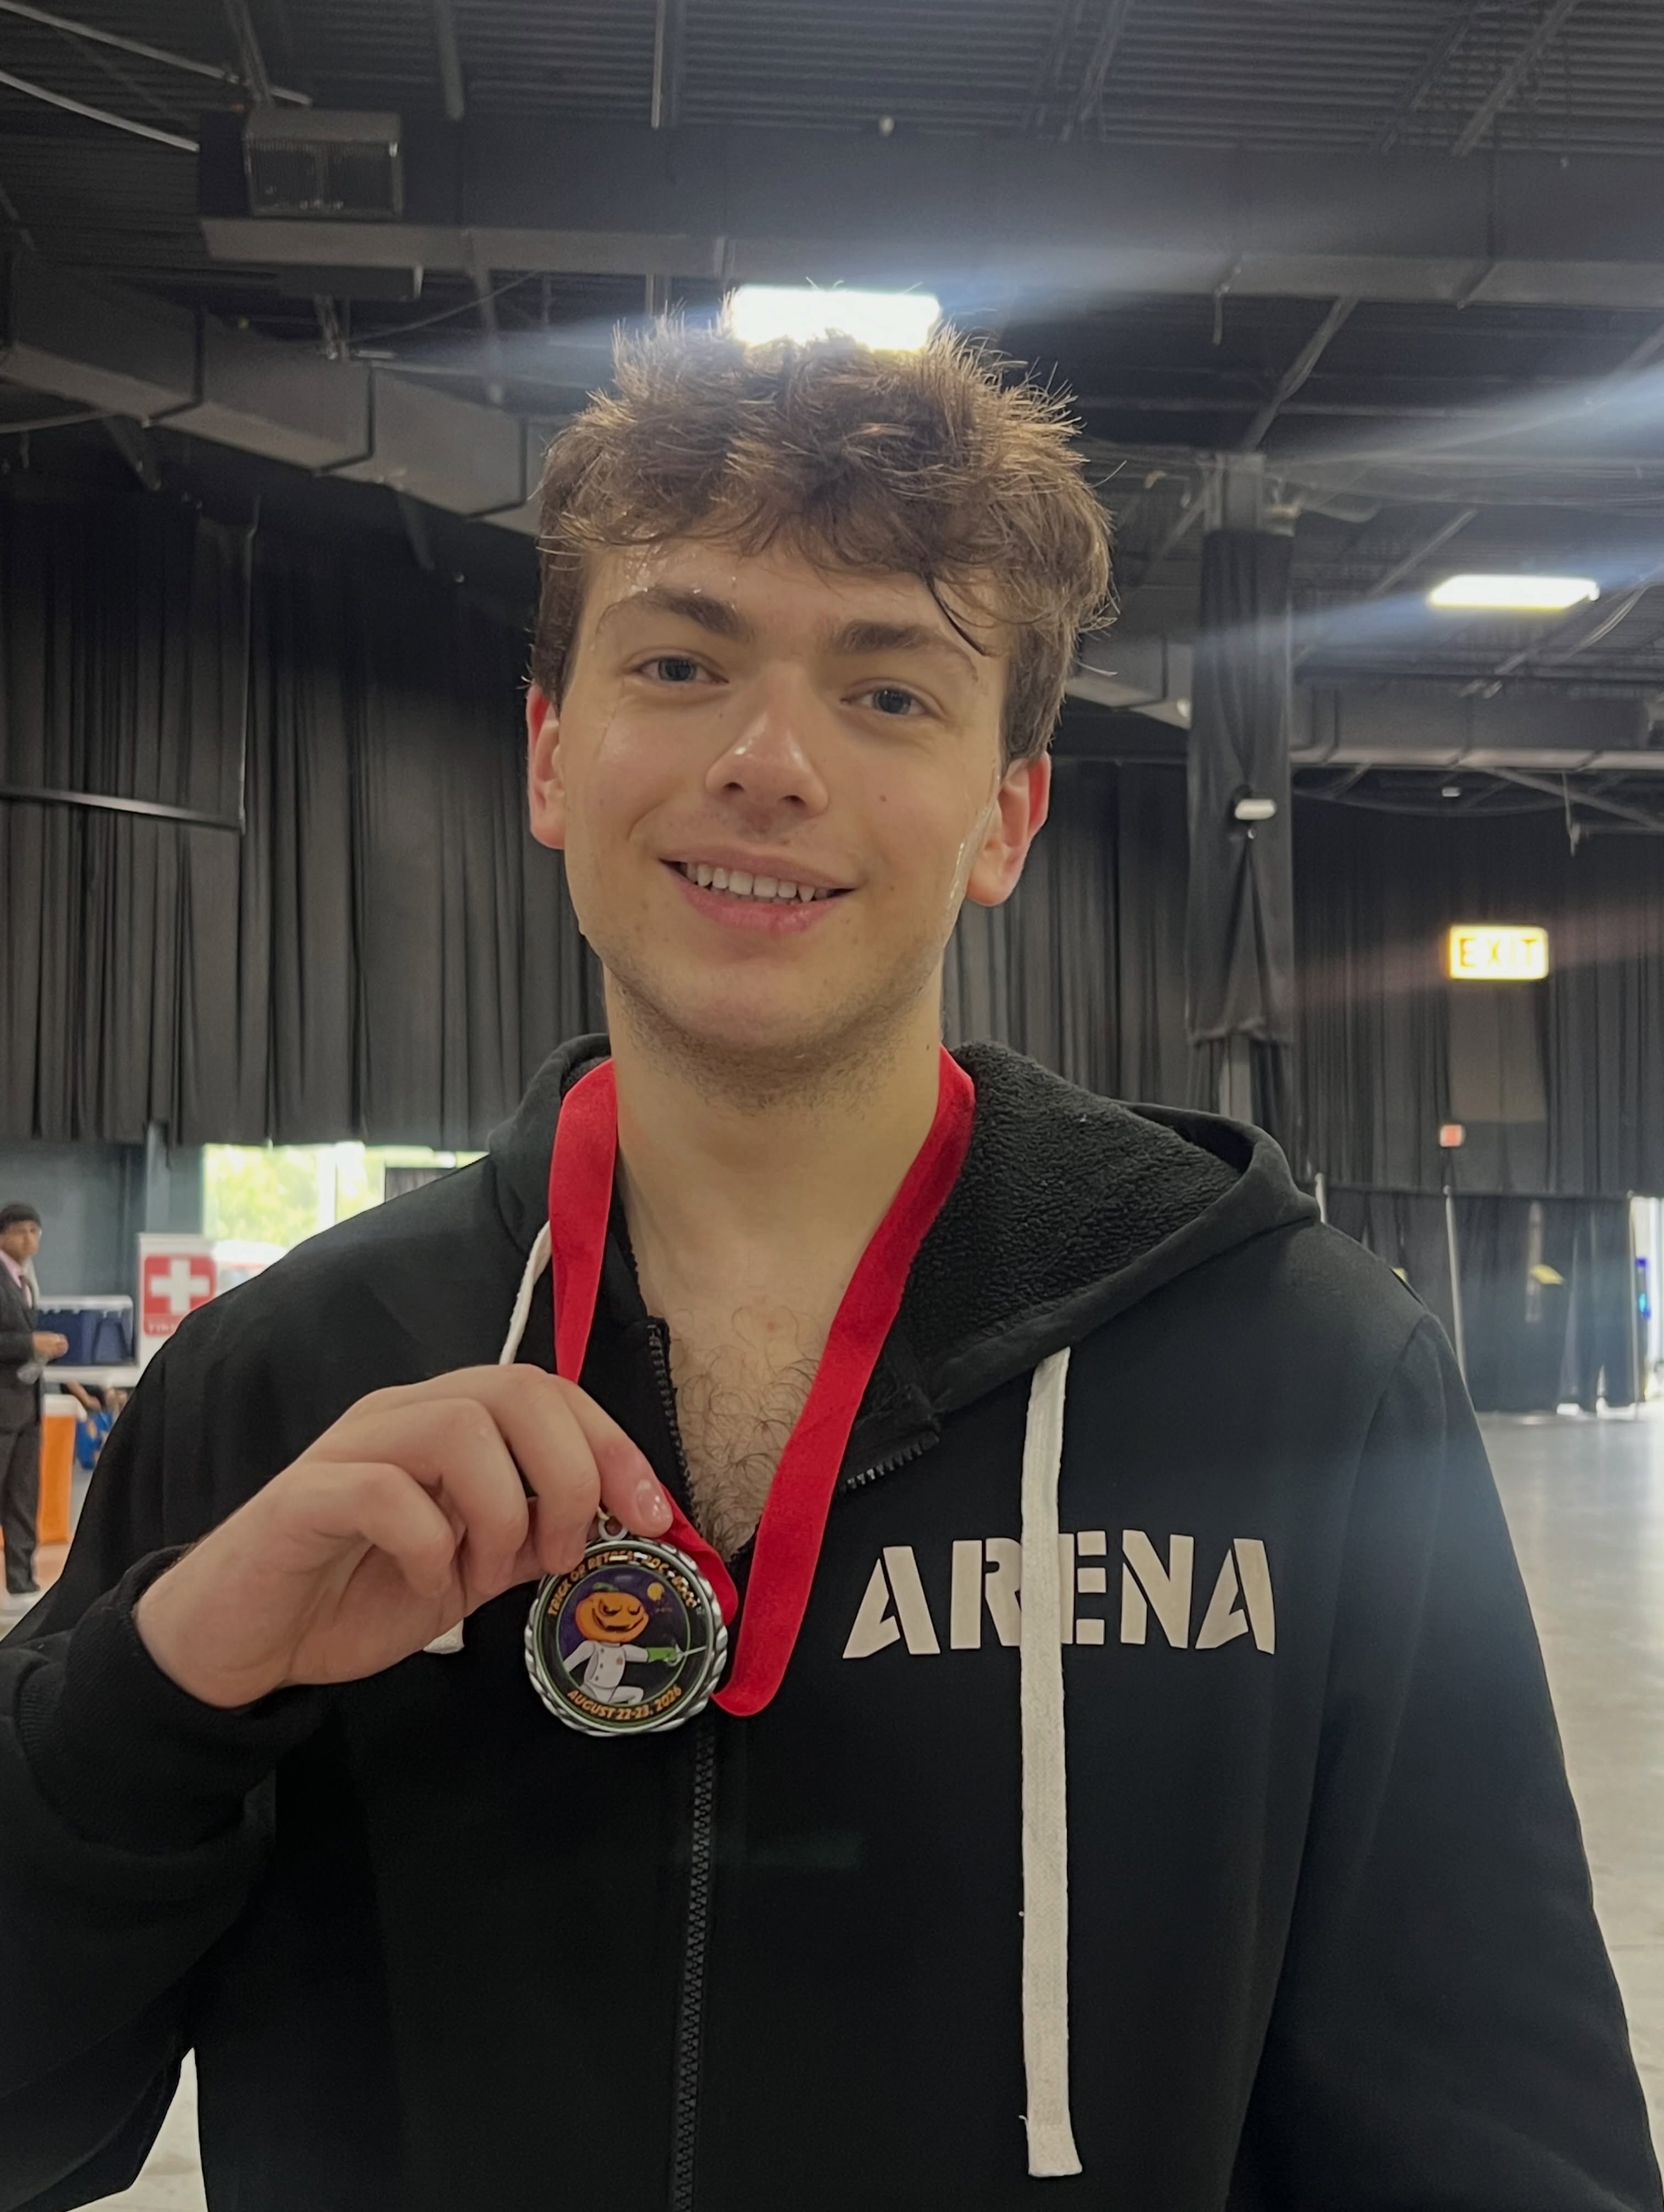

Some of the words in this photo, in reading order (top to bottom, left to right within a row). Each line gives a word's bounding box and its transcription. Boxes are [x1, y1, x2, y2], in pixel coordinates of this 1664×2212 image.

[1460, 938, 1537, 967] EXIT
[548, 1578, 572, 1615] TRICK
[571, 1564, 585, 1582] OR
[842, 1529, 1275, 1659] ARENA
[567, 1689, 616, 1719] AUGUST
[655, 1684, 682, 1711] 2026
